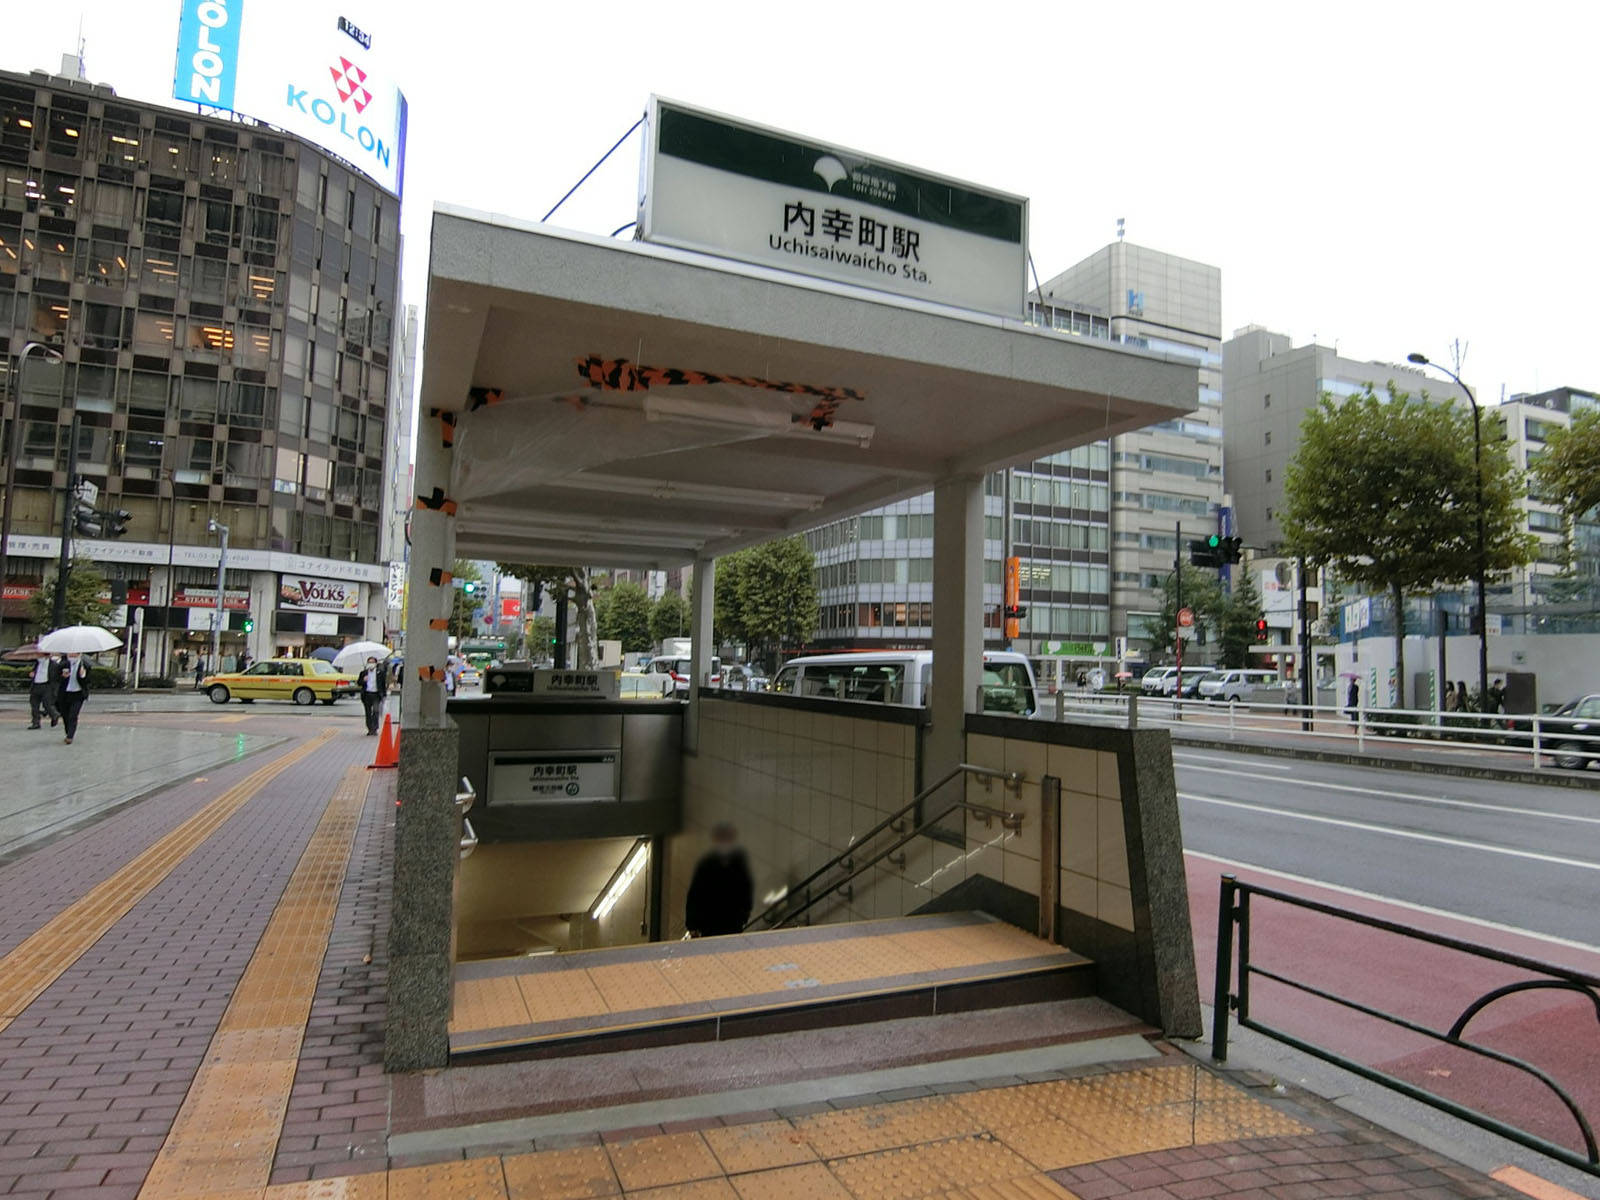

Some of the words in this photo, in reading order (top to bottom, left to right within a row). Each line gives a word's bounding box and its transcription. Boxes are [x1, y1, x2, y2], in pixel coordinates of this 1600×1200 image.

[191, 0, 228, 102] OLON
[287, 84, 390, 168] KOLON
[769, 233, 897, 275] Uchisaiwaicho
[902, 264, 932, 284] Sta.
[784, 201, 920, 262] 内幸町駅
[298, 580, 345, 602] VOLKS
